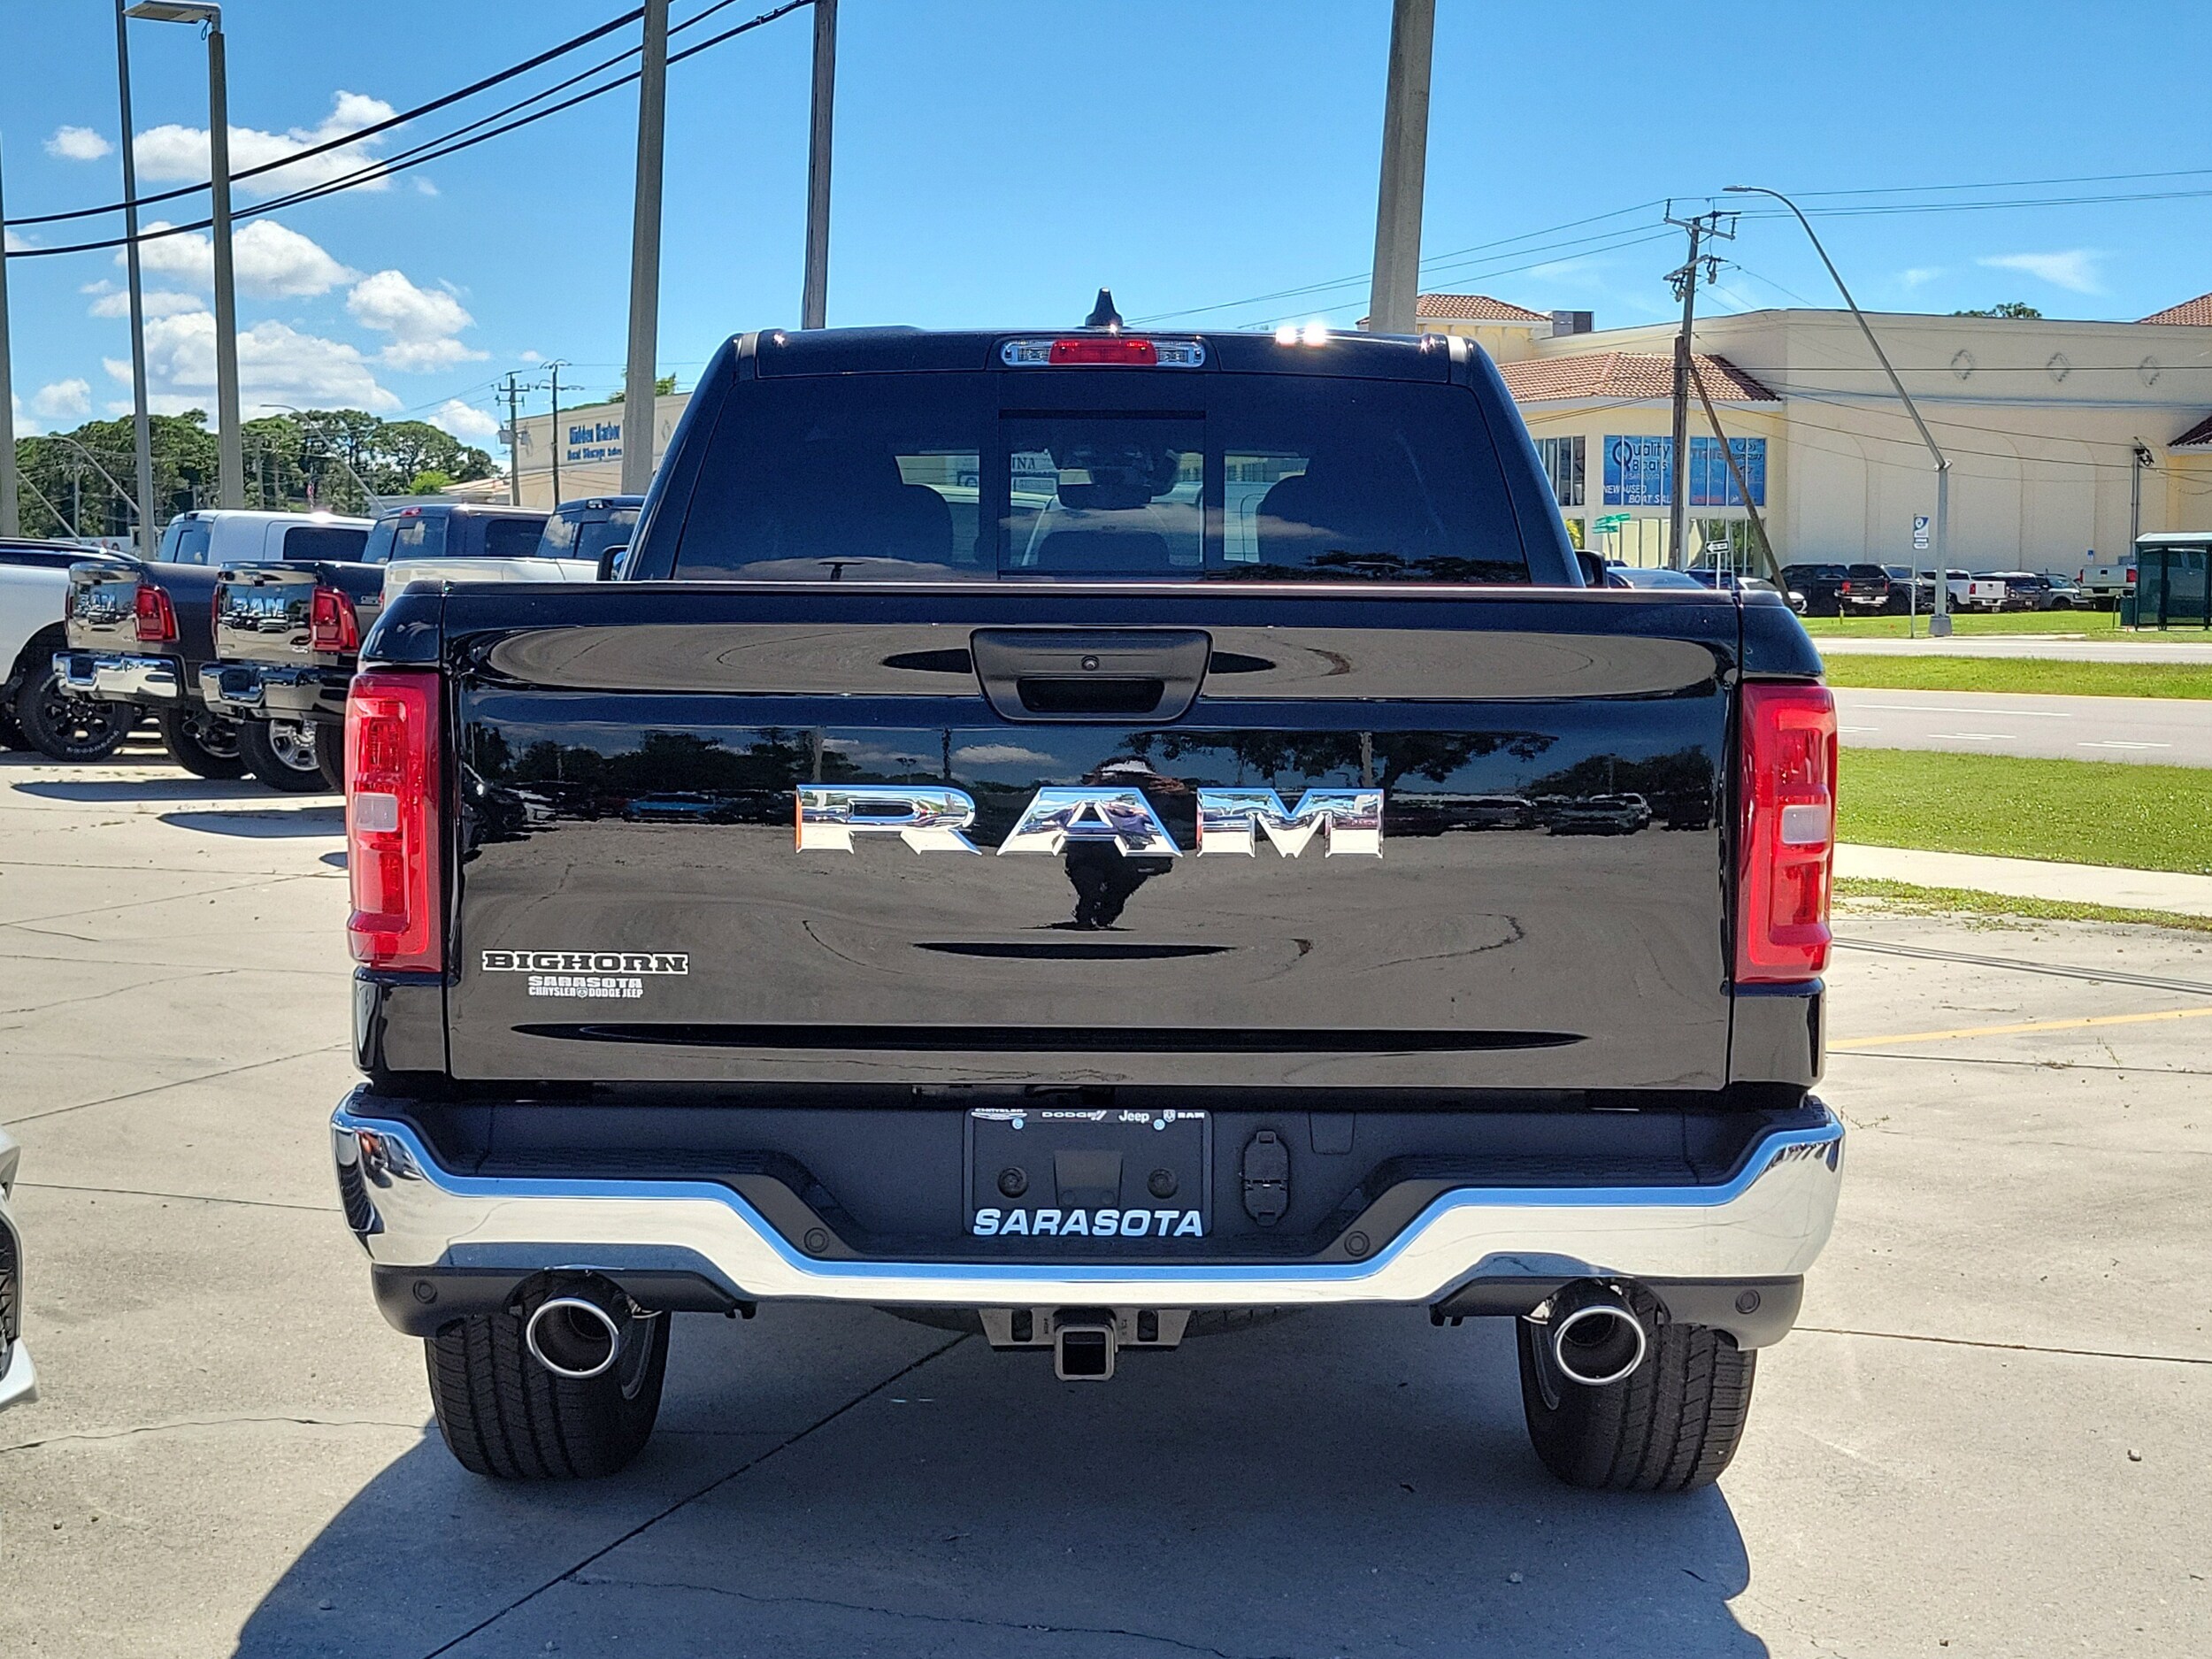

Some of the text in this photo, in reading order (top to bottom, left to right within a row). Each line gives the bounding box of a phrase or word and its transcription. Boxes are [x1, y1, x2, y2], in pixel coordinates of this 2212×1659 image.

[1612, 439, 1671, 472] Quality
[1632, 459, 1668, 472] Boats
[1625, 485, 1647, 495] USED
[1629, 494, 1653, 504] BOAT
[233, 597, 285, 618] RAM
[795, 785, 1384, 859] RAM
[482, 950, 689, 975] BIGHORN
[527, 975, 643, 988] SARASOTA
[528, 987, 644, 999] CHRYSLER DODGE JEEP
[1118, 1110, 1150, 1124] Jeep
[972, 1208, 1203, 1237] SARASOTA
